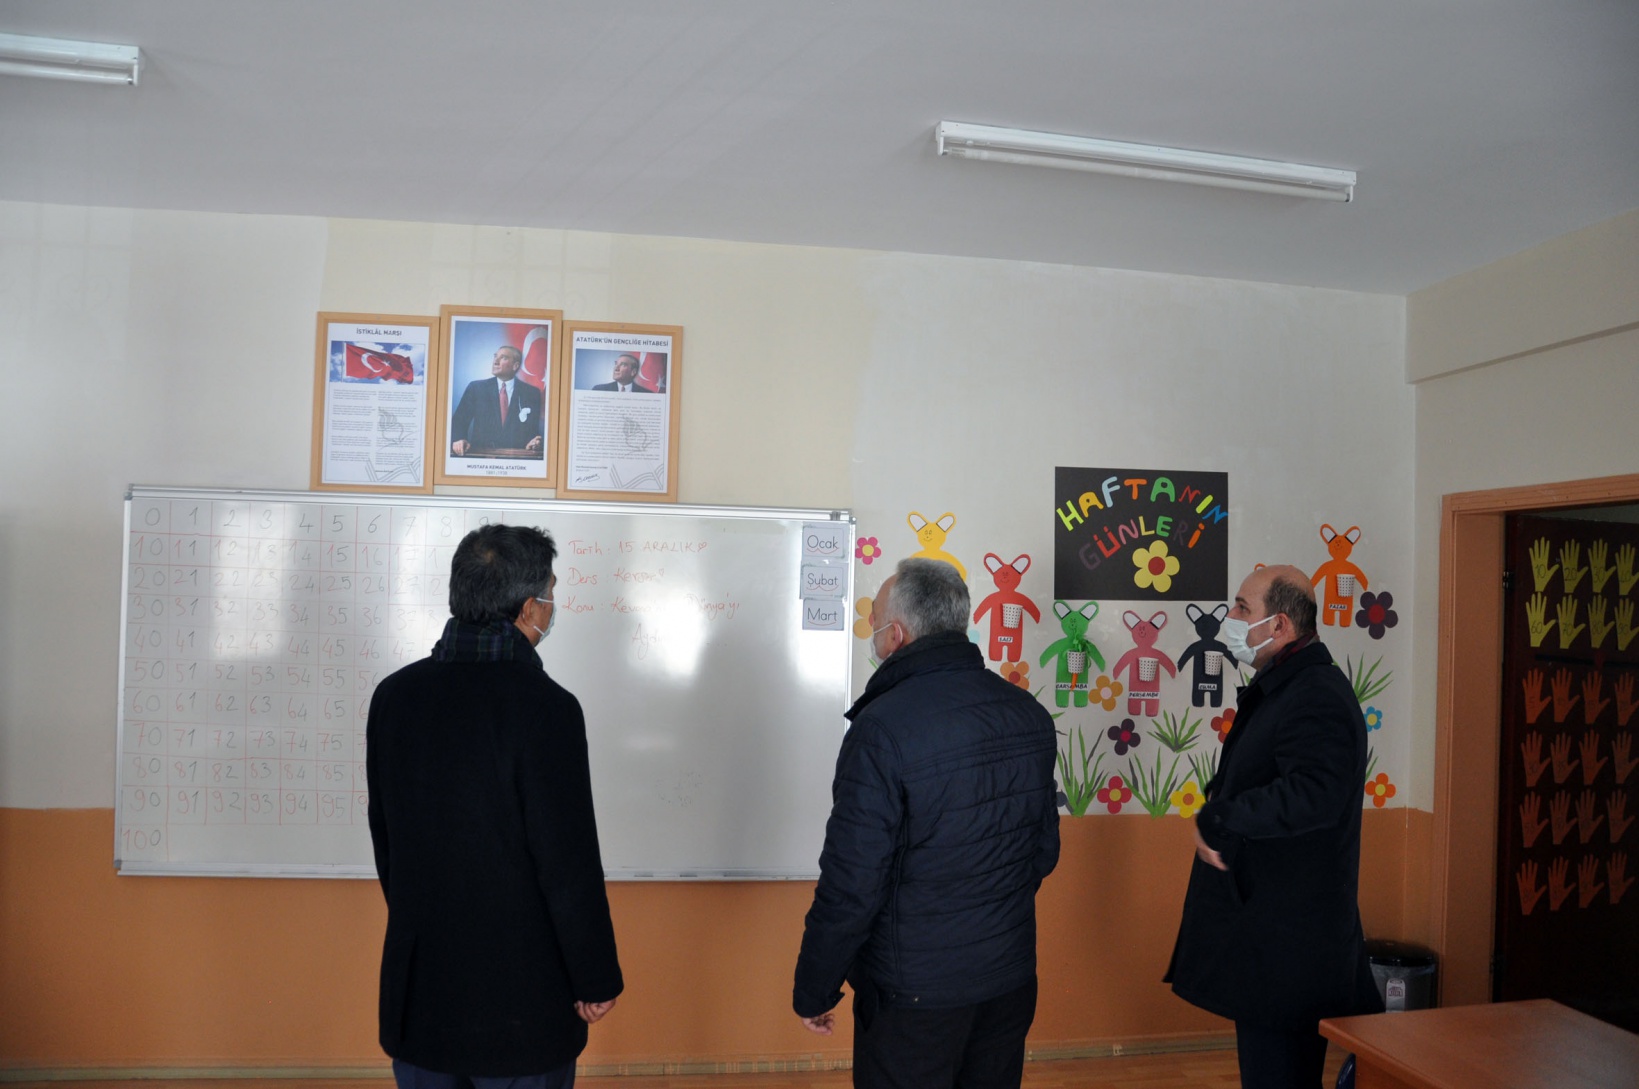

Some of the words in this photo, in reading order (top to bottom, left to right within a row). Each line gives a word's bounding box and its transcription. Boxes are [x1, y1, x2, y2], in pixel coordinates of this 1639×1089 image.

[1056, 476, 1228, 532] HAFTANIN
[145, 507, 161, 526] 0
[189, 506, 198, 525] 1
[224, 509, 241, 527] 2
[259, 509, 272, 529] 3
[299, 513, 314, 533] 4
[332, 515, 344, 532] 5
[368, 514, 382, 533] 6
[404, 517, 416, 536] 7
[441, 516, 452, 537] 8
[134, 536, 163, 558] 10
[175, 540, 197, 558] 11
[215, 540, 237, 558] 12
[252, 541, 277, 563] 13
[289, 541, 312, 564] 14
[327, 544, 349, 567] 15
[362, 546, 383, 567] 16
[619, 541, 636, 554] 15
[643, 541, 695, 553] ARALIK
[807, 535, 838, 549] Ocak
[1078, 515, 1205, 570] GÜNLERİ
[134, 567, 165, 589] 20
[174, 569, 198, 586] 21
[214, 571, 243, 586] 22
[289, 575, 314, 590] 24
[326, 576, 352, 591] 25
[362, 577, 385, 593] 26
[808, 573, 838, 587] Şubat
[1535, 563, 1546, 578] 10
[1564, 567, 1577, 581] 20
[133, 596, 164, 619] 30
[175, 598, 198, 616] 31
[215, 601, 238, 616] 32
[253, 602, 278, 620] 33
[290, 604, 309, 625] 34
[328, 606, 348, 626] 35
[362, 607, 382, 627] 36
[808, 607, 838, 621] Mart
[1531, 620, 1542, 634] 60
[134, 627, 161, 652] 40
[176, 630, 194, 652] 41
[215, 633, 239, 654] 42
[250, 632, 274, 655] 43
[288, 636, 310, 657] 44
[322, 637, 345, 658] 45
[359, 640, 380, 659] 46
[134, 661, 165, 681] 50
[176, 662, 197, 682] 51
[215, 664, 237, 680] 52
[252, 666, 275, 685] 53
[287, 667, 310, 687] 54
[323, 669, 345, 688] 55
[133, 691, 161, 713] 60
[176, 691, 196, 712] 61
[215, 693, 238, 712] 62
[249, 695, 271, 714] 63
[288, 696, 307, 721] 64
[324, 698, 345, 719] 65
[133, 722, 162, 748] 70
[174, 729, 196, 747] 71
[214, 730, 236, 748] 72
[250, 731, 275, 748] 73
[283, 731, 307, 752] 74
[317, 733, 343, 752] 75
[133, 756, 161, 778] 80
[175, 760, 197, 782] 81
[212, 763, 238, 782] 82
[250, 763, 271, 779] 83
[284, 763, 305, 780] 84
[322, 764, 345, 781] 85
[130, 789, 161, 812] 90
[176, 791, 199, 814] 91
[212, 791, 242, 813] 92
[250, 793, 273, 814] 93
[286, 793, 307, 815] 94
[322, 793, 345, 818] 95
[123, 829, 161, 852] 100
